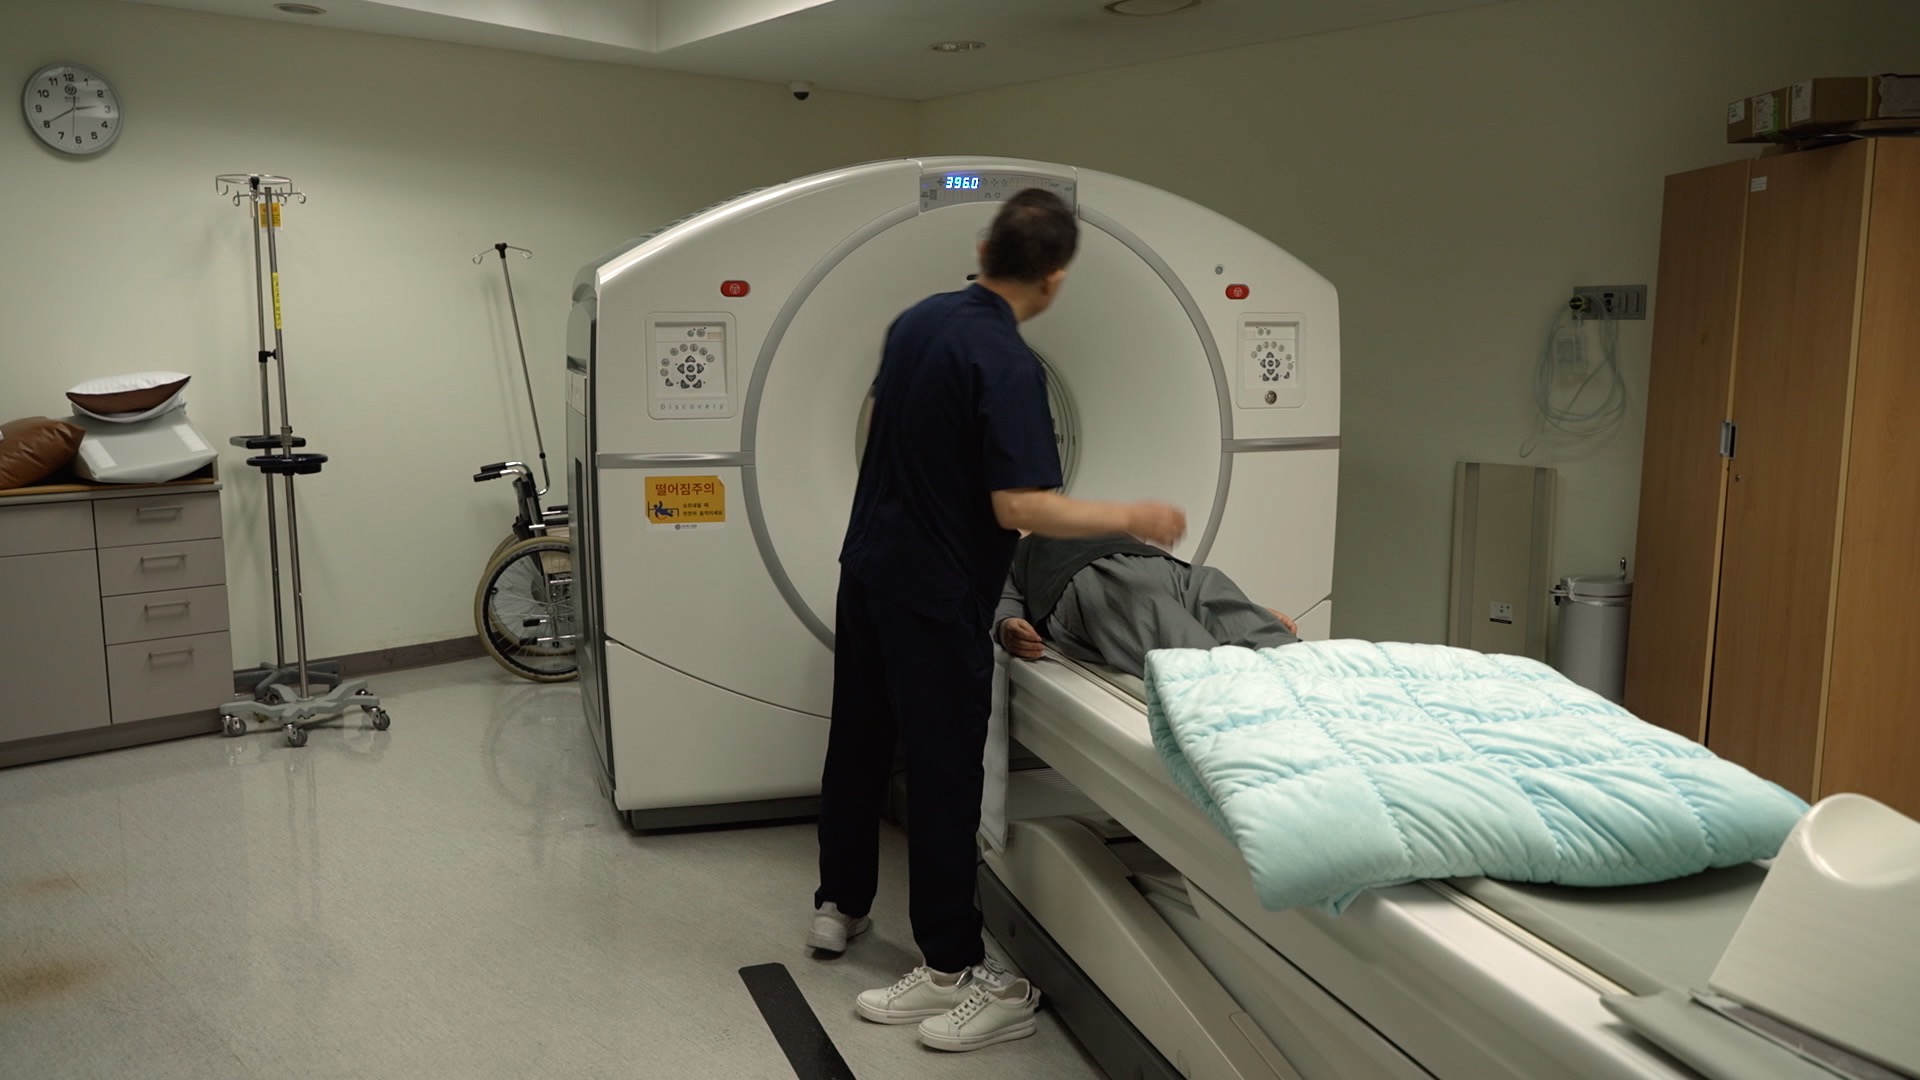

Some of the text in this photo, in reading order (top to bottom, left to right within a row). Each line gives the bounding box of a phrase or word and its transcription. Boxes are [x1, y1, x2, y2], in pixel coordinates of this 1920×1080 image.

[48, 77, 58, 86] 11
[63, 74, 74, 82] 12
[84, 78, 89, 86] 1
[37, 89, 49, 98] 10
[97, 89, 104, 98] 2
[104, 105, 111, 113] 3
[43, 120, 50, 128] 8
[58, 131, 64, 140] 7
[75, 136, 82, 144] 6
[91, 131, 98, 140] 5
[945, 176, 979, 189] 396.0
[656, 483, 715, 496] 떨어짐주의
